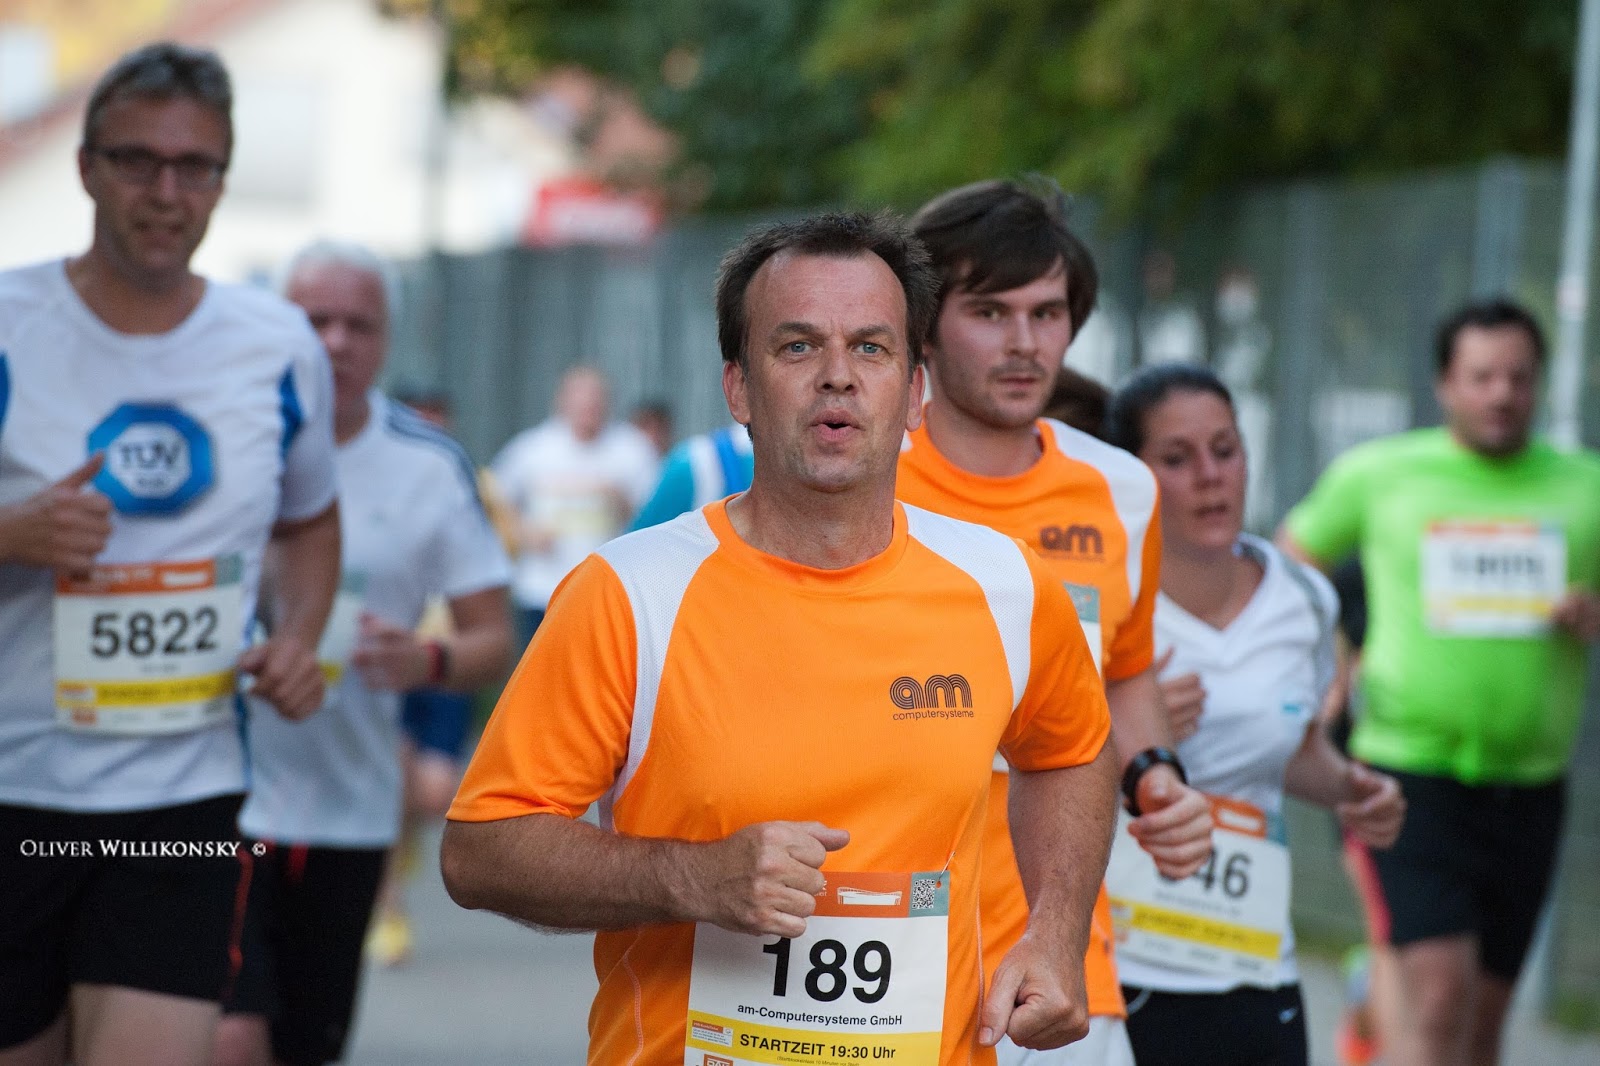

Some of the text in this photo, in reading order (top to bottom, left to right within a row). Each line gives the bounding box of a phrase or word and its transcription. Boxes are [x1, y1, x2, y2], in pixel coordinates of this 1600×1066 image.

[1040, 525, 1104, 554] am
[92, 607, 218, 659] 5822
[890, 674, 973, 710] am
[893, 710, 975, 721] computersysteme
[763, 936, 892, 1004] 189
[737, 1004, 867, 1026] am-Computersysteme
[870, 1015, 903, 1026] GmbH
[740, 1033, 826, 1056] STARTZEIT
[830, 1045, 869, 1059] 19:30
[873, 1046, 896, 1059] Uhr
